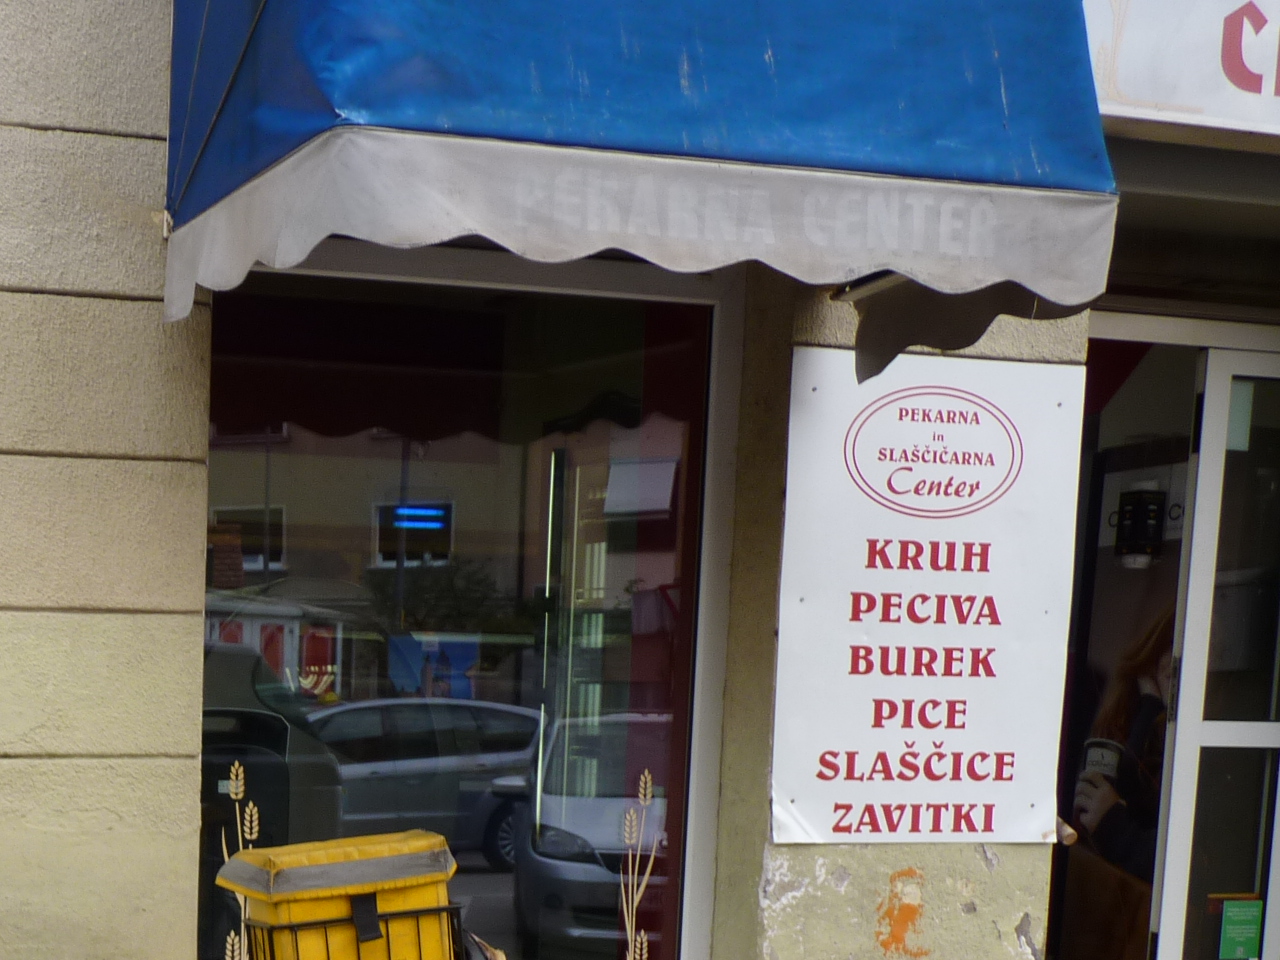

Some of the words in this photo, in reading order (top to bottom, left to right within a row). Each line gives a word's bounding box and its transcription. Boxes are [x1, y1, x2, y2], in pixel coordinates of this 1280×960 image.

[517, 166, 775, 244] PEKARNA
[803, 187, 999, 256] CENTER
[898, 407, 980, 425] PEKARNA
[932, 431, 945, 442] in
[877, 444, 995, 467] SLAŠČIČARNA
[886, 466, 980, 497] Center
[866, 538, 991, 573] KRUH
[850, 592, 1002, 626] PECIVA
[849, 645, 996, 677] BUREK
[872, 699, 967, 729] PICE
[817, 741, 1016, 782] SLAŠČICE
[832, 803, 995, 834] ZAVITKI
